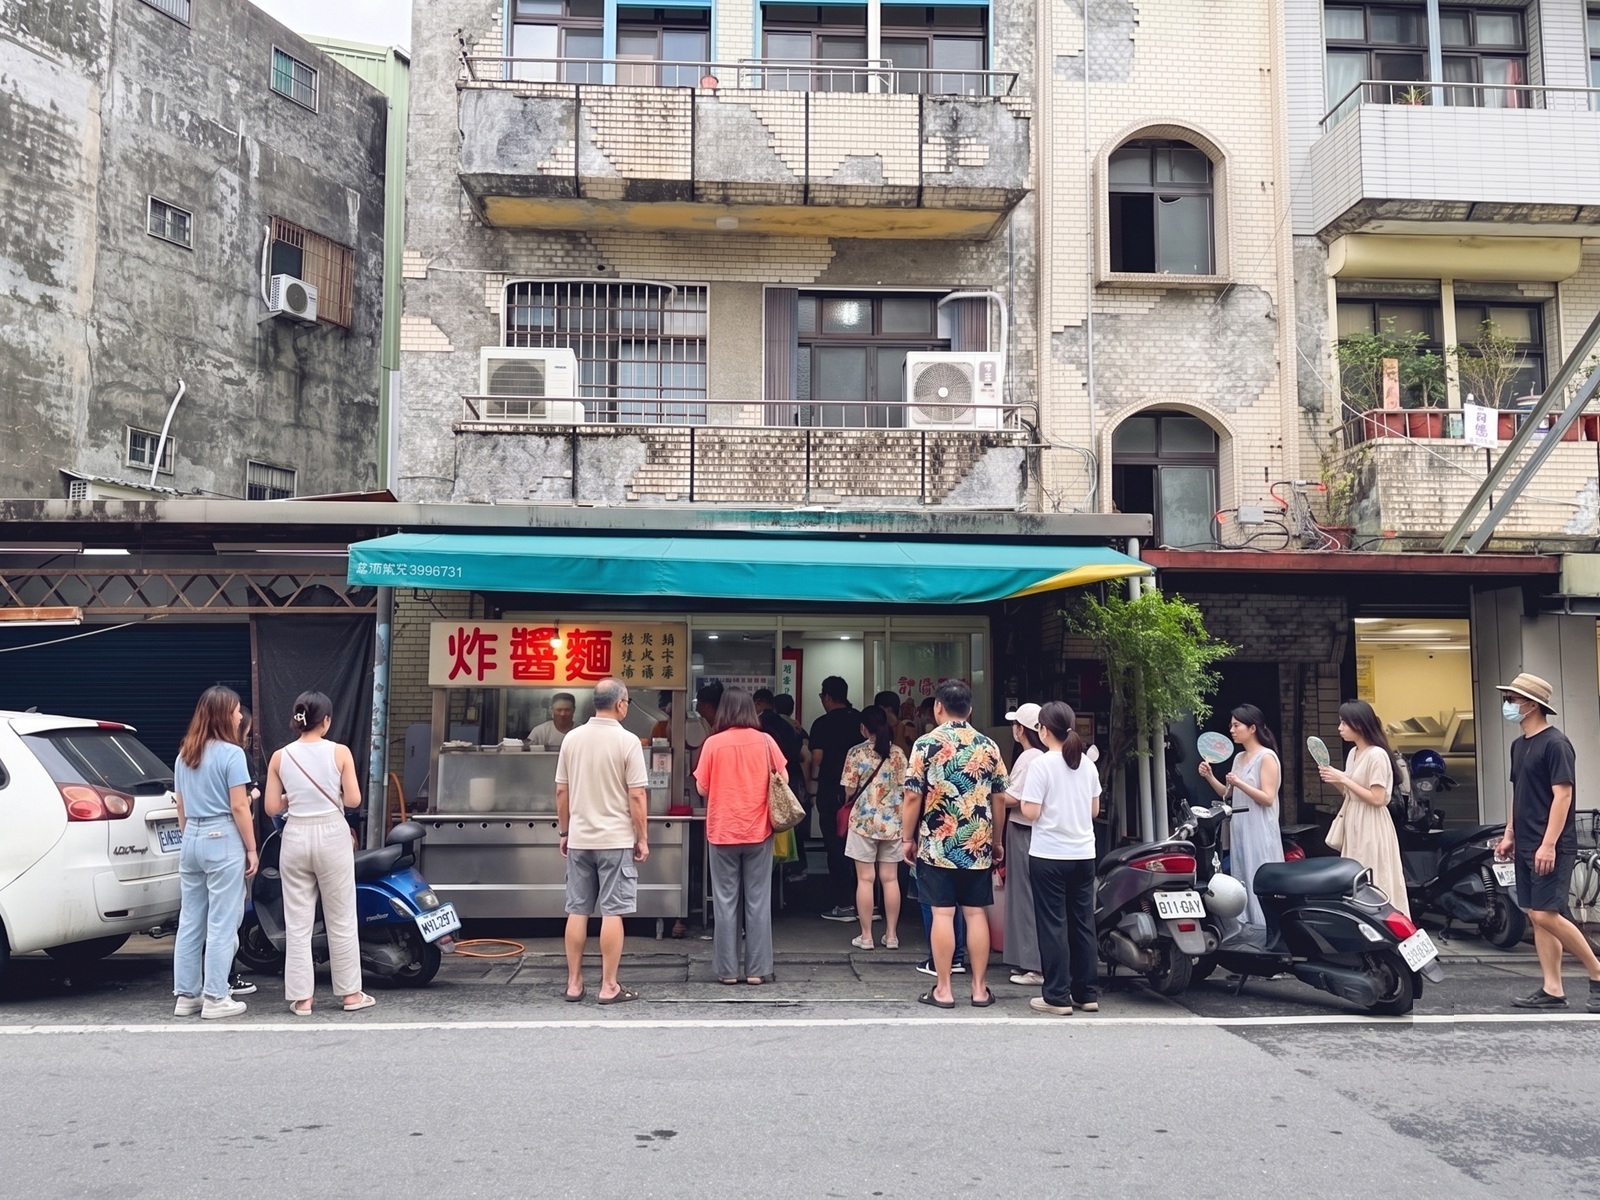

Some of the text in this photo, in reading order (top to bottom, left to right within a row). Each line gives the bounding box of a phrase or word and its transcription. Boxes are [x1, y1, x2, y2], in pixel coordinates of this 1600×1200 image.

[409, 564, 463, 578] 3996731
[448, 625, 613, 682] 炸醬麵
